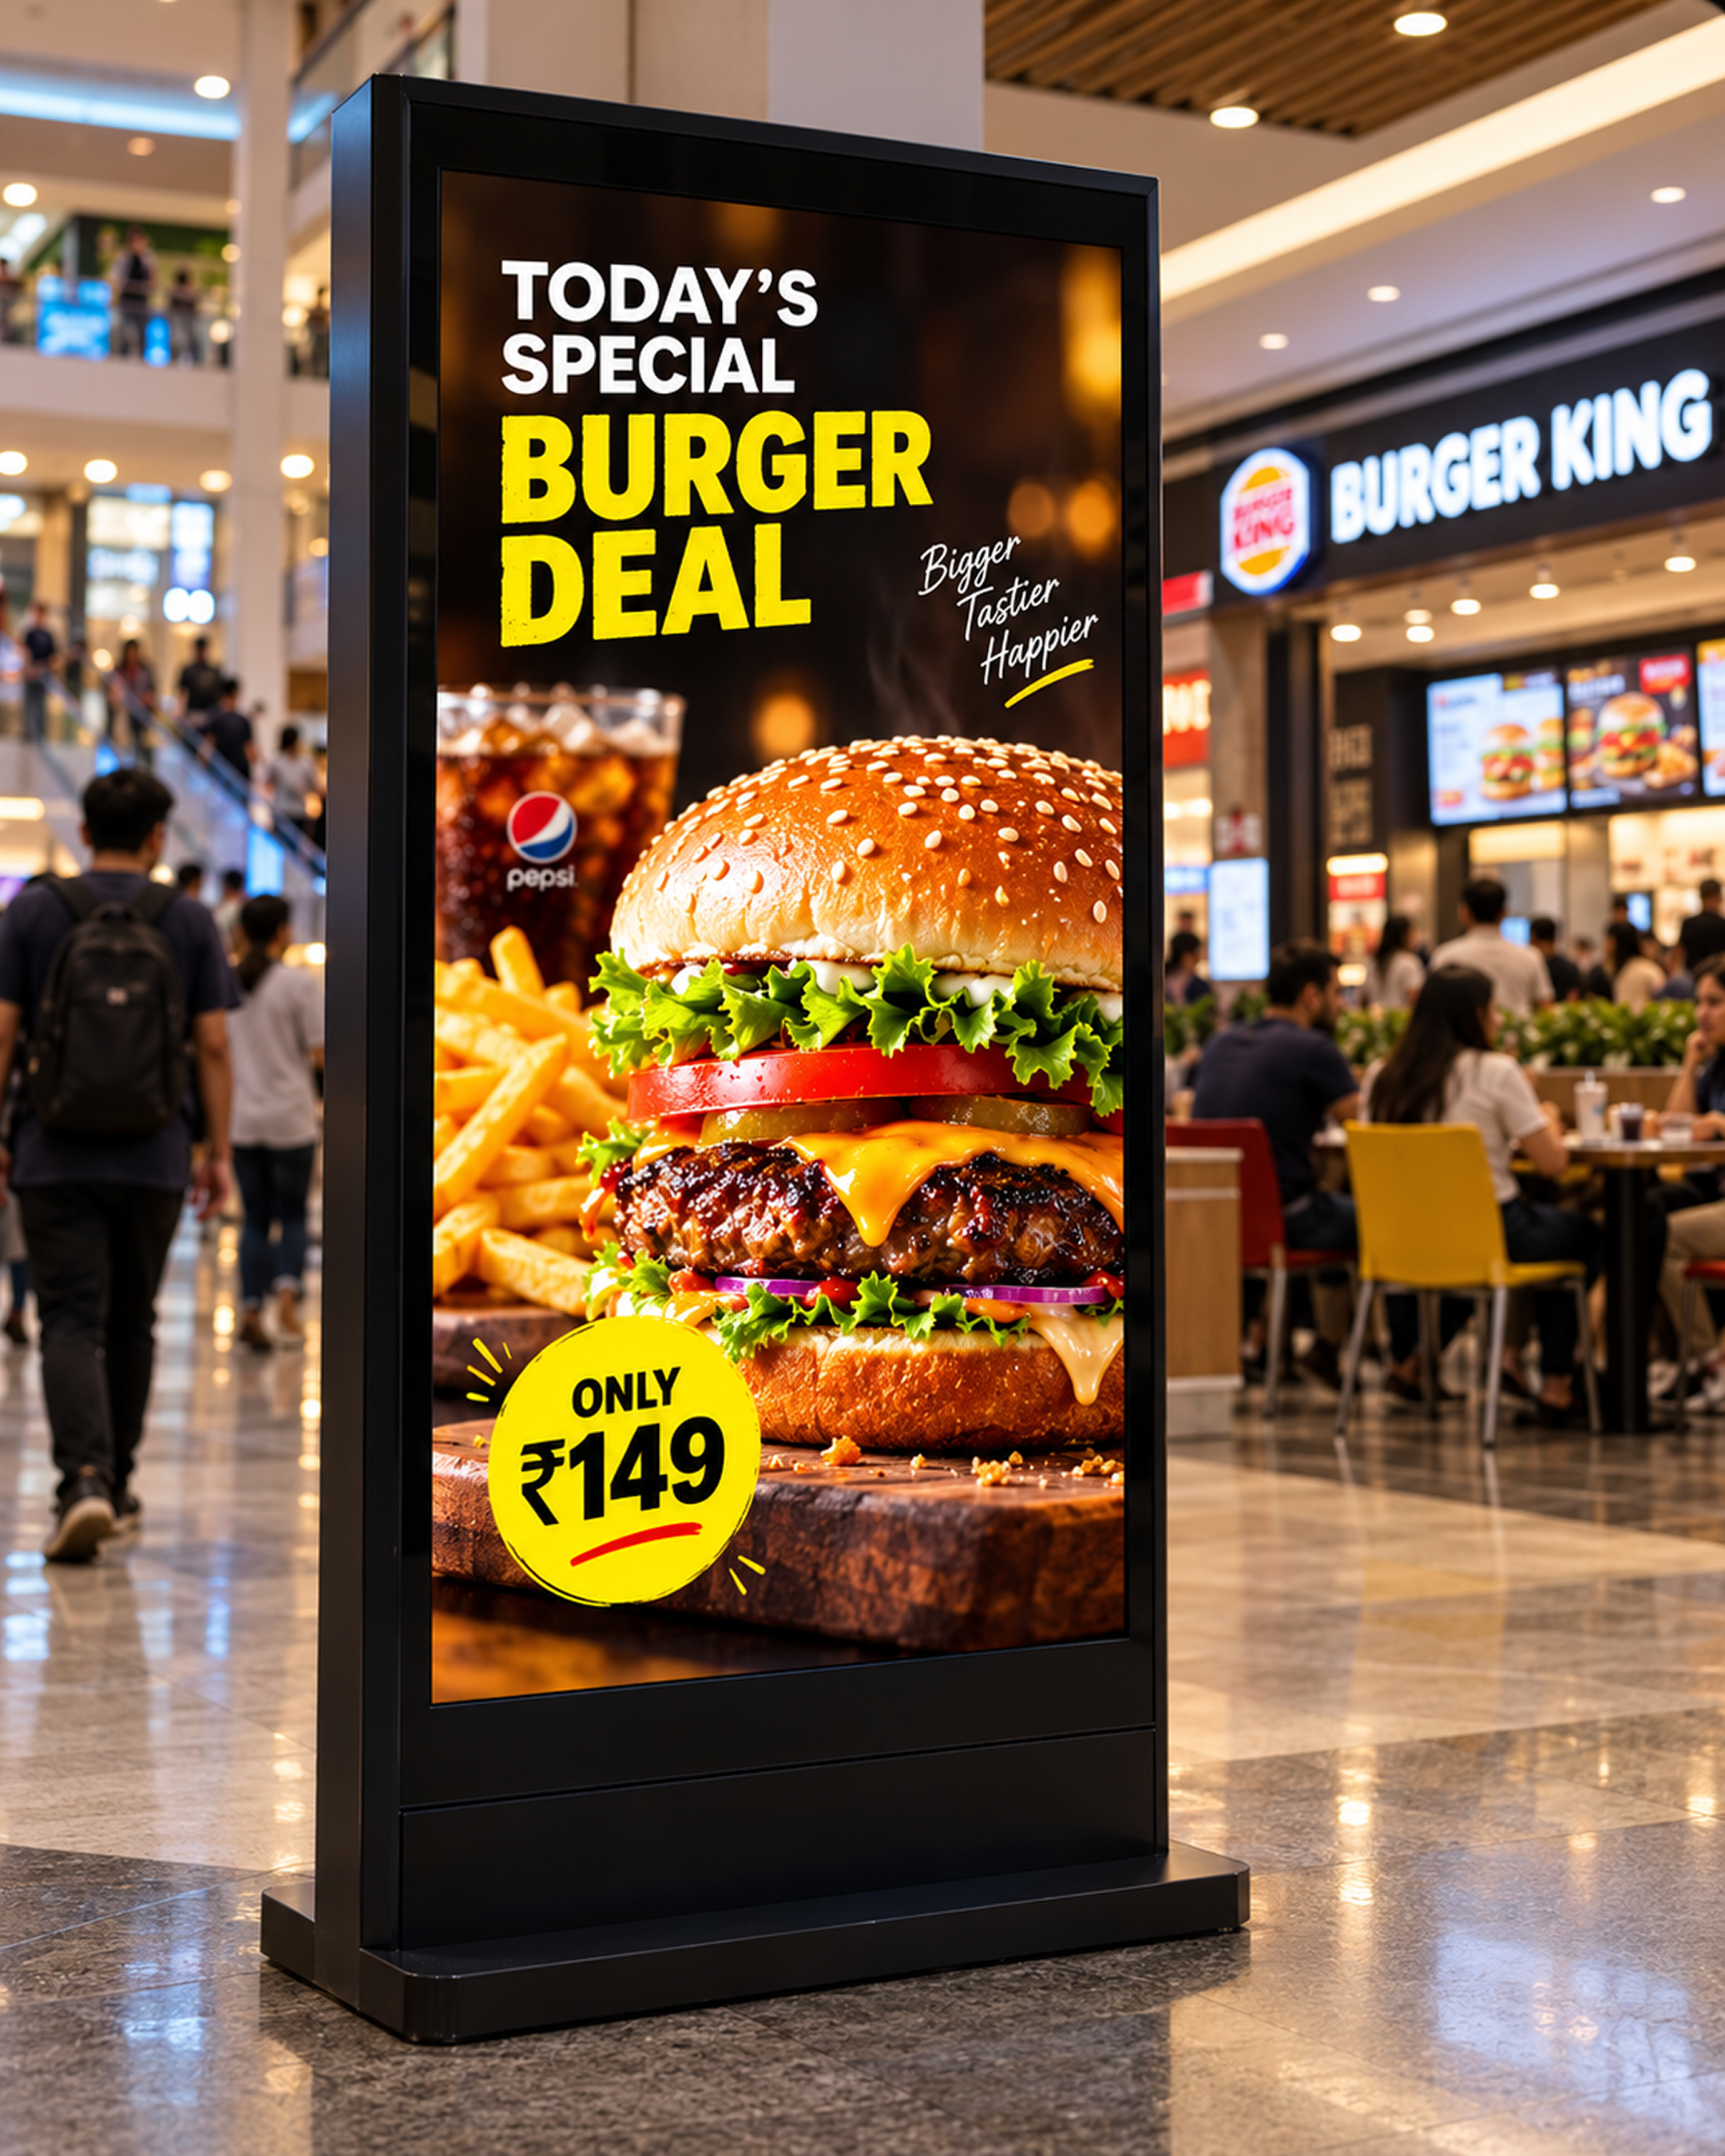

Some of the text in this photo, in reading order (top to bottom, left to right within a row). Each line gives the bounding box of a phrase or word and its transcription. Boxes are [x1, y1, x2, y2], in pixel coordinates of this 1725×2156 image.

[502, 260, 819, 328] TODAY’S
[501, 333, 796, 394] SPECIAL
[501, 410, 934, 524] BURGER
[1330, 368, 1713, 544] BURGER KING
[500, 522, 812, 648] DEAL
[918, 535, 1022, 596] Bigger
[956, 576, 1061, 642] Tastier
[980, 613, 1100, 686] Happier
[506, 863, 575, 892] pepsi
[572, 1366, 681, 1418] ONLY
[520, 1416, 725, 1527] ₹149
